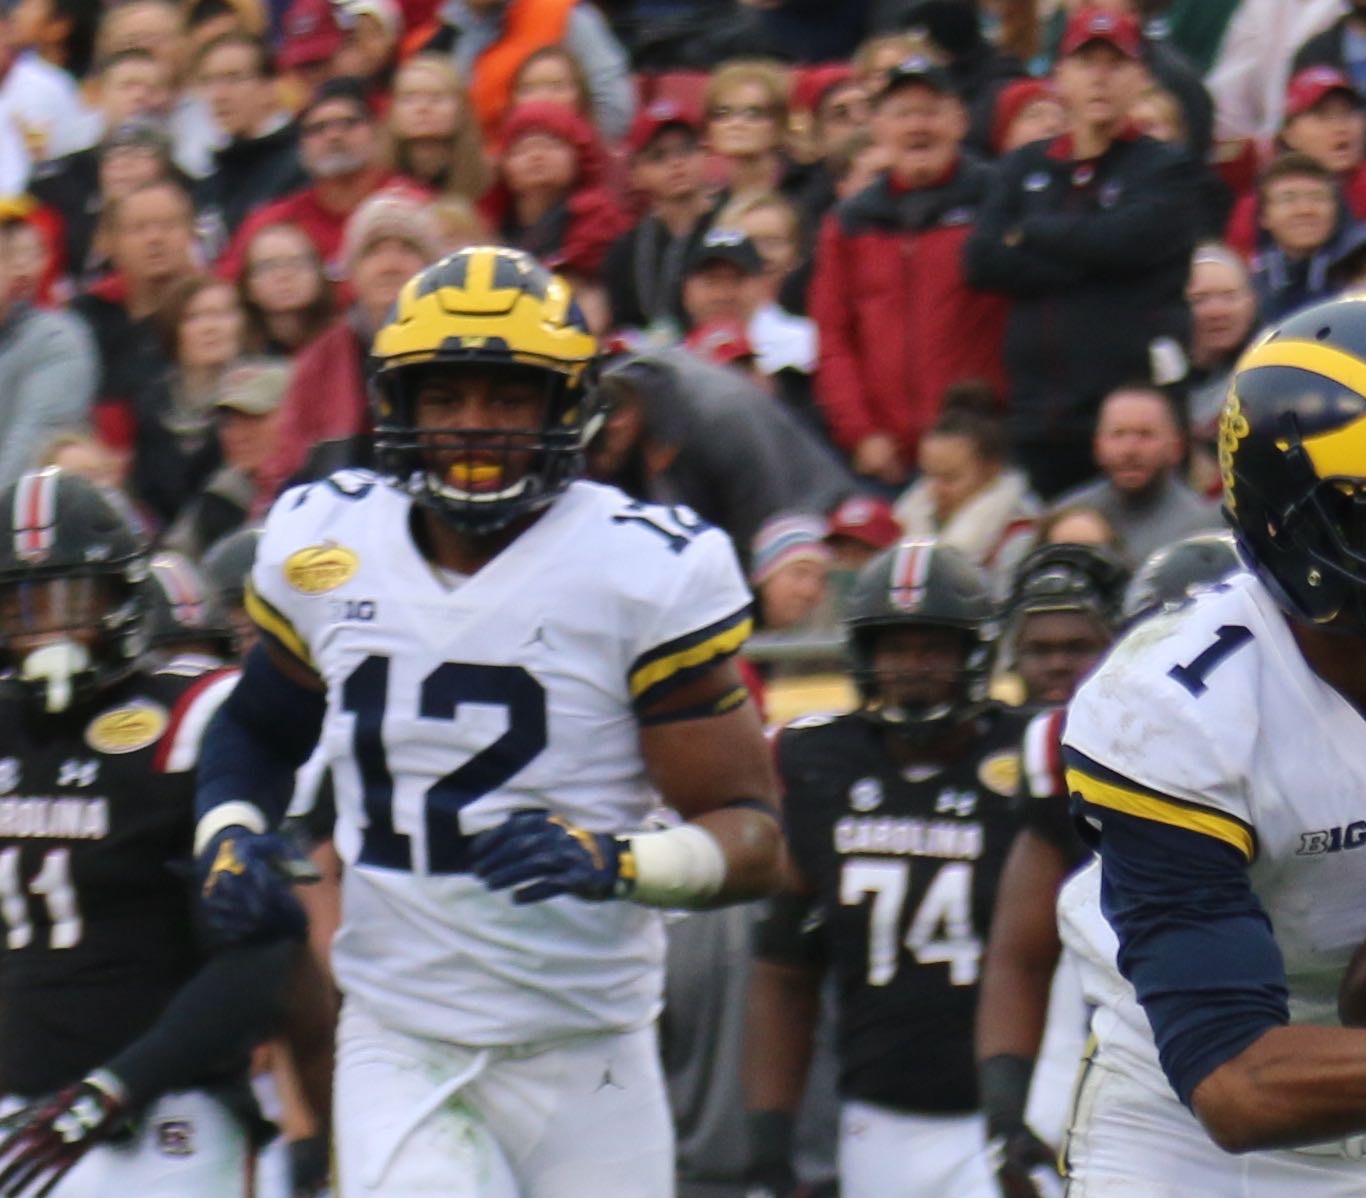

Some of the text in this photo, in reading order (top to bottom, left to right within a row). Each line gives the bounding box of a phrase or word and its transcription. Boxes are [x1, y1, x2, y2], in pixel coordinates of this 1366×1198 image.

[1165, 624, 1255, 700] 1
[342, 654, 549, 876] 12
[838, 858, 983, 988] 74
